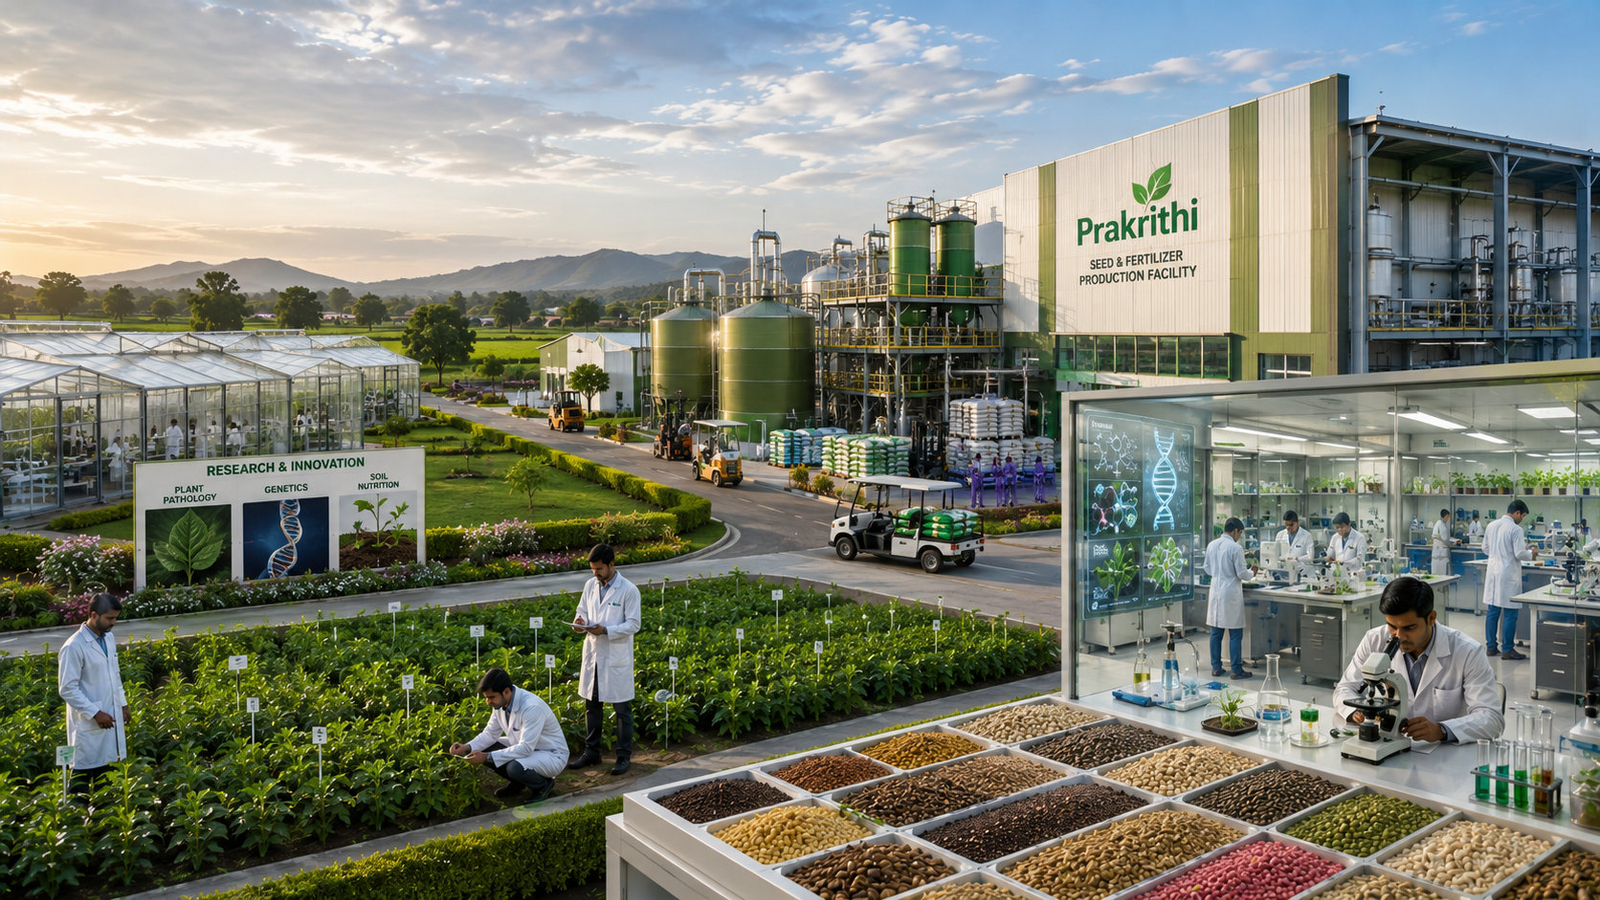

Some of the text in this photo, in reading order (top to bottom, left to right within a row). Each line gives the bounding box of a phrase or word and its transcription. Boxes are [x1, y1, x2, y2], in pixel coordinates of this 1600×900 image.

[1077, 197, 1198, 246] Prakrithi
[1090, 250, 1183, 270] SEED & FERTILIZER
[1079, 265, 1197, 286] PRODUCTION FACILITY
[207, 457, 365, 477] RESEARCH & INNOVATION
[370, 473, 388, 481] SOIL
[174, 485, 204, 494] PLANT
[264, 483, 308, 494] GENETICS
[358, 481, 399, 491] NUTRITION
[163, 493, 217, 505] PATHOLOGY
